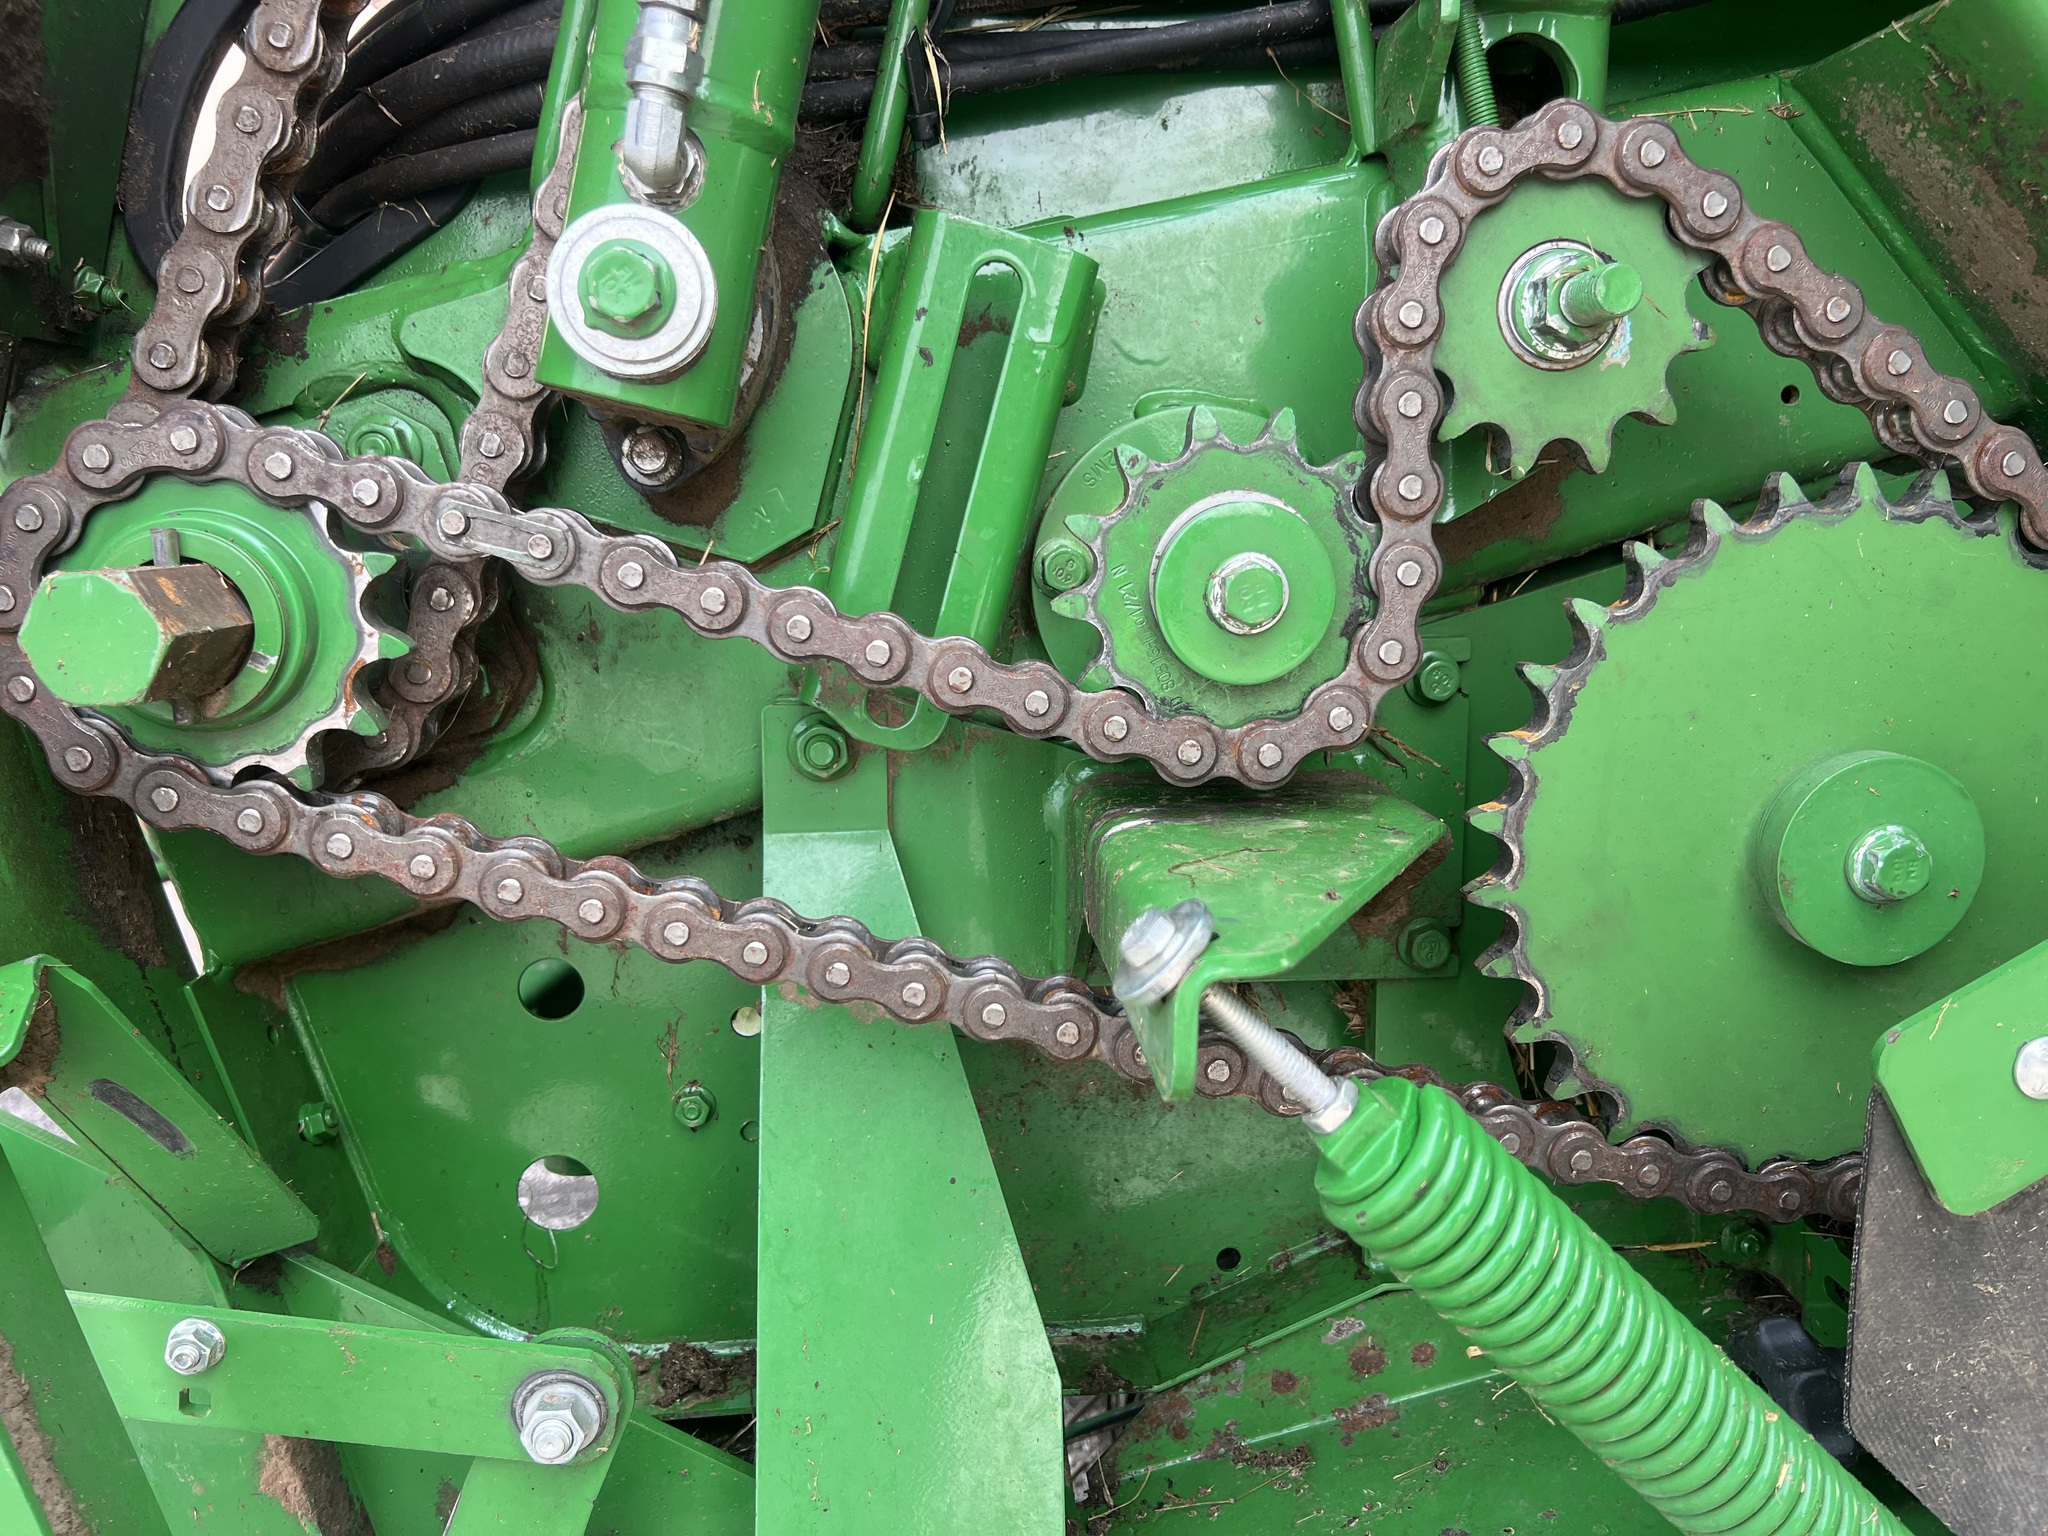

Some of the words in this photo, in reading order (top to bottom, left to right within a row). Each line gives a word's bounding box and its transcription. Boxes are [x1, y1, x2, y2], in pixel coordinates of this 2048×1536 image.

[1051, 564, 1075, 587] 10.9
[1111, 563, 1127, 579] N
[1118, 581, 1146, 627] 01/21
[1431, 665, 1456, 690] 10.9
